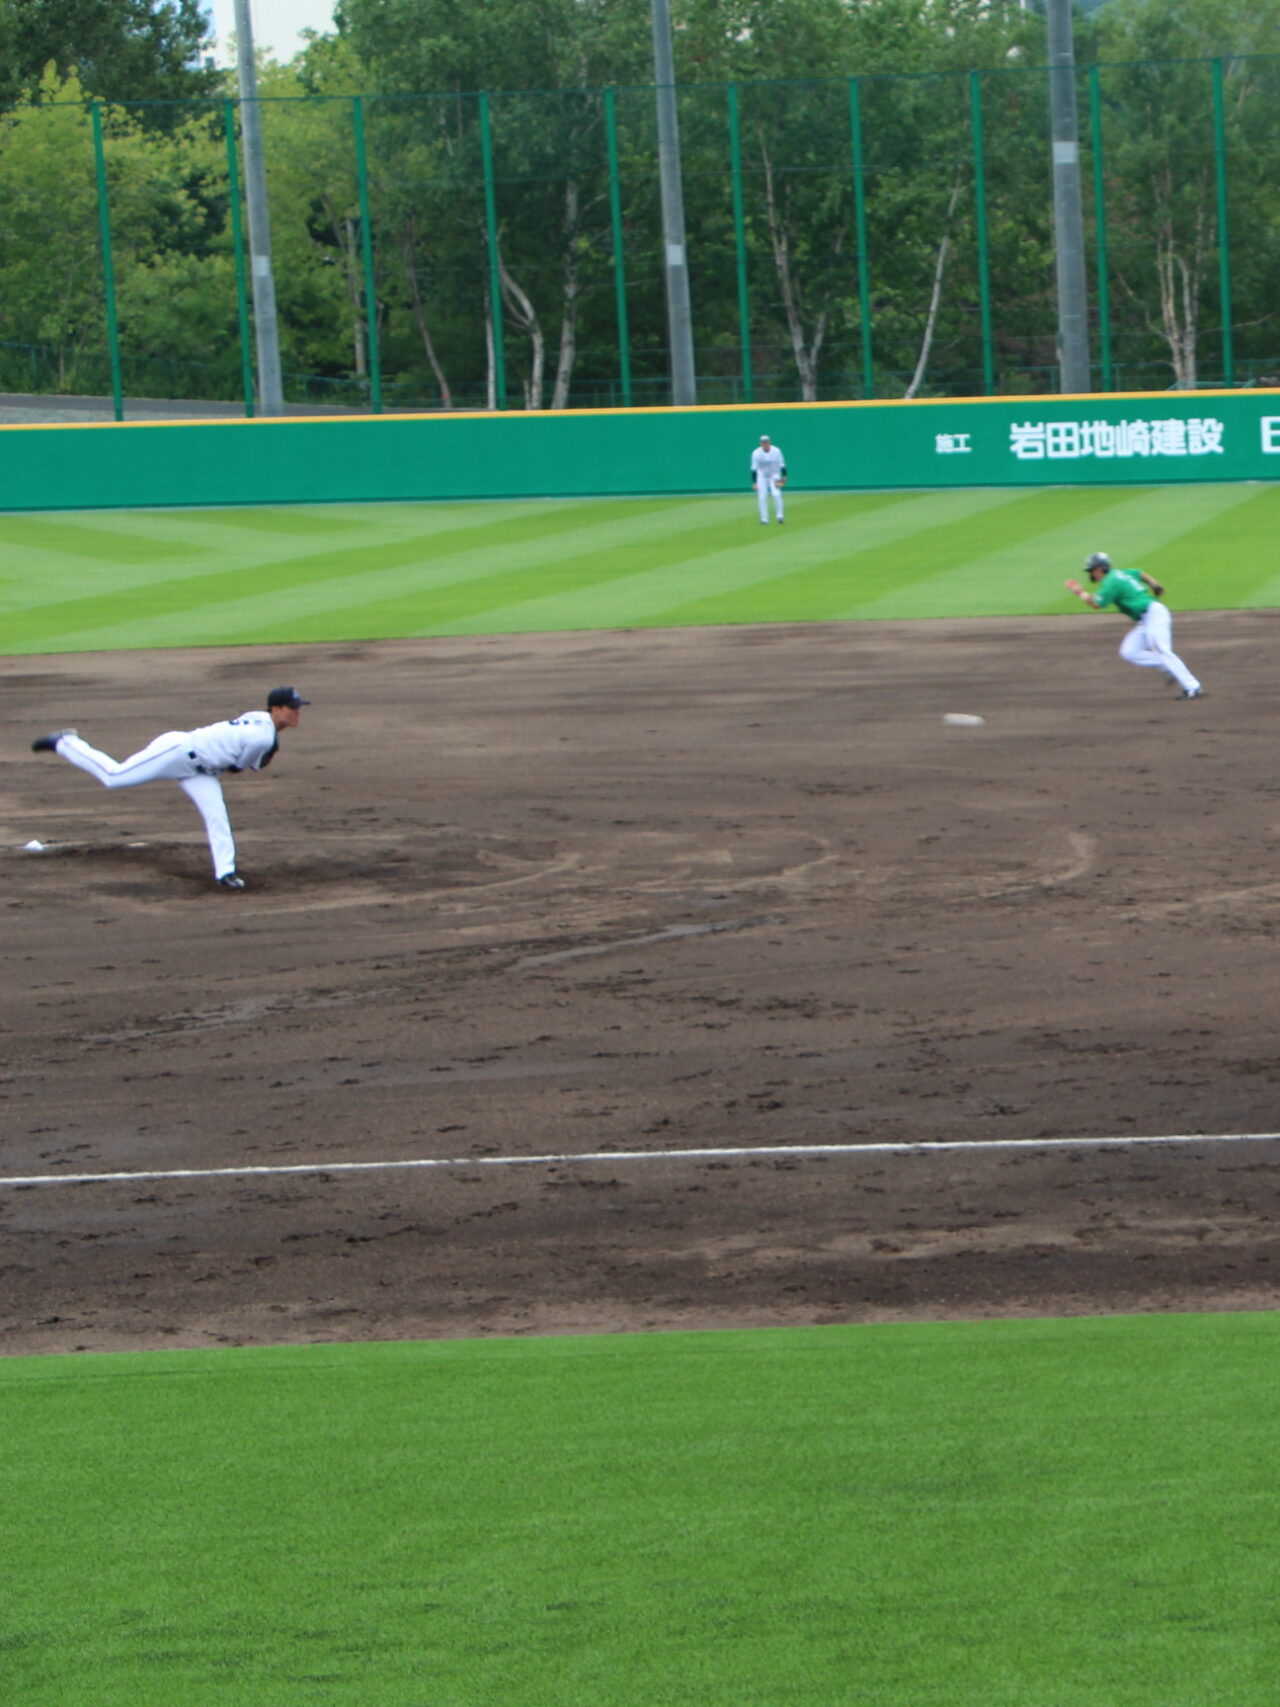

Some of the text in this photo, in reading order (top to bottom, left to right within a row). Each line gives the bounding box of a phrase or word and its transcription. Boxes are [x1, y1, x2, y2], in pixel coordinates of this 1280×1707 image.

[935, 433, 972, 453] 施工
[1009, 418, 1224, 460] 岩田地崎建設
